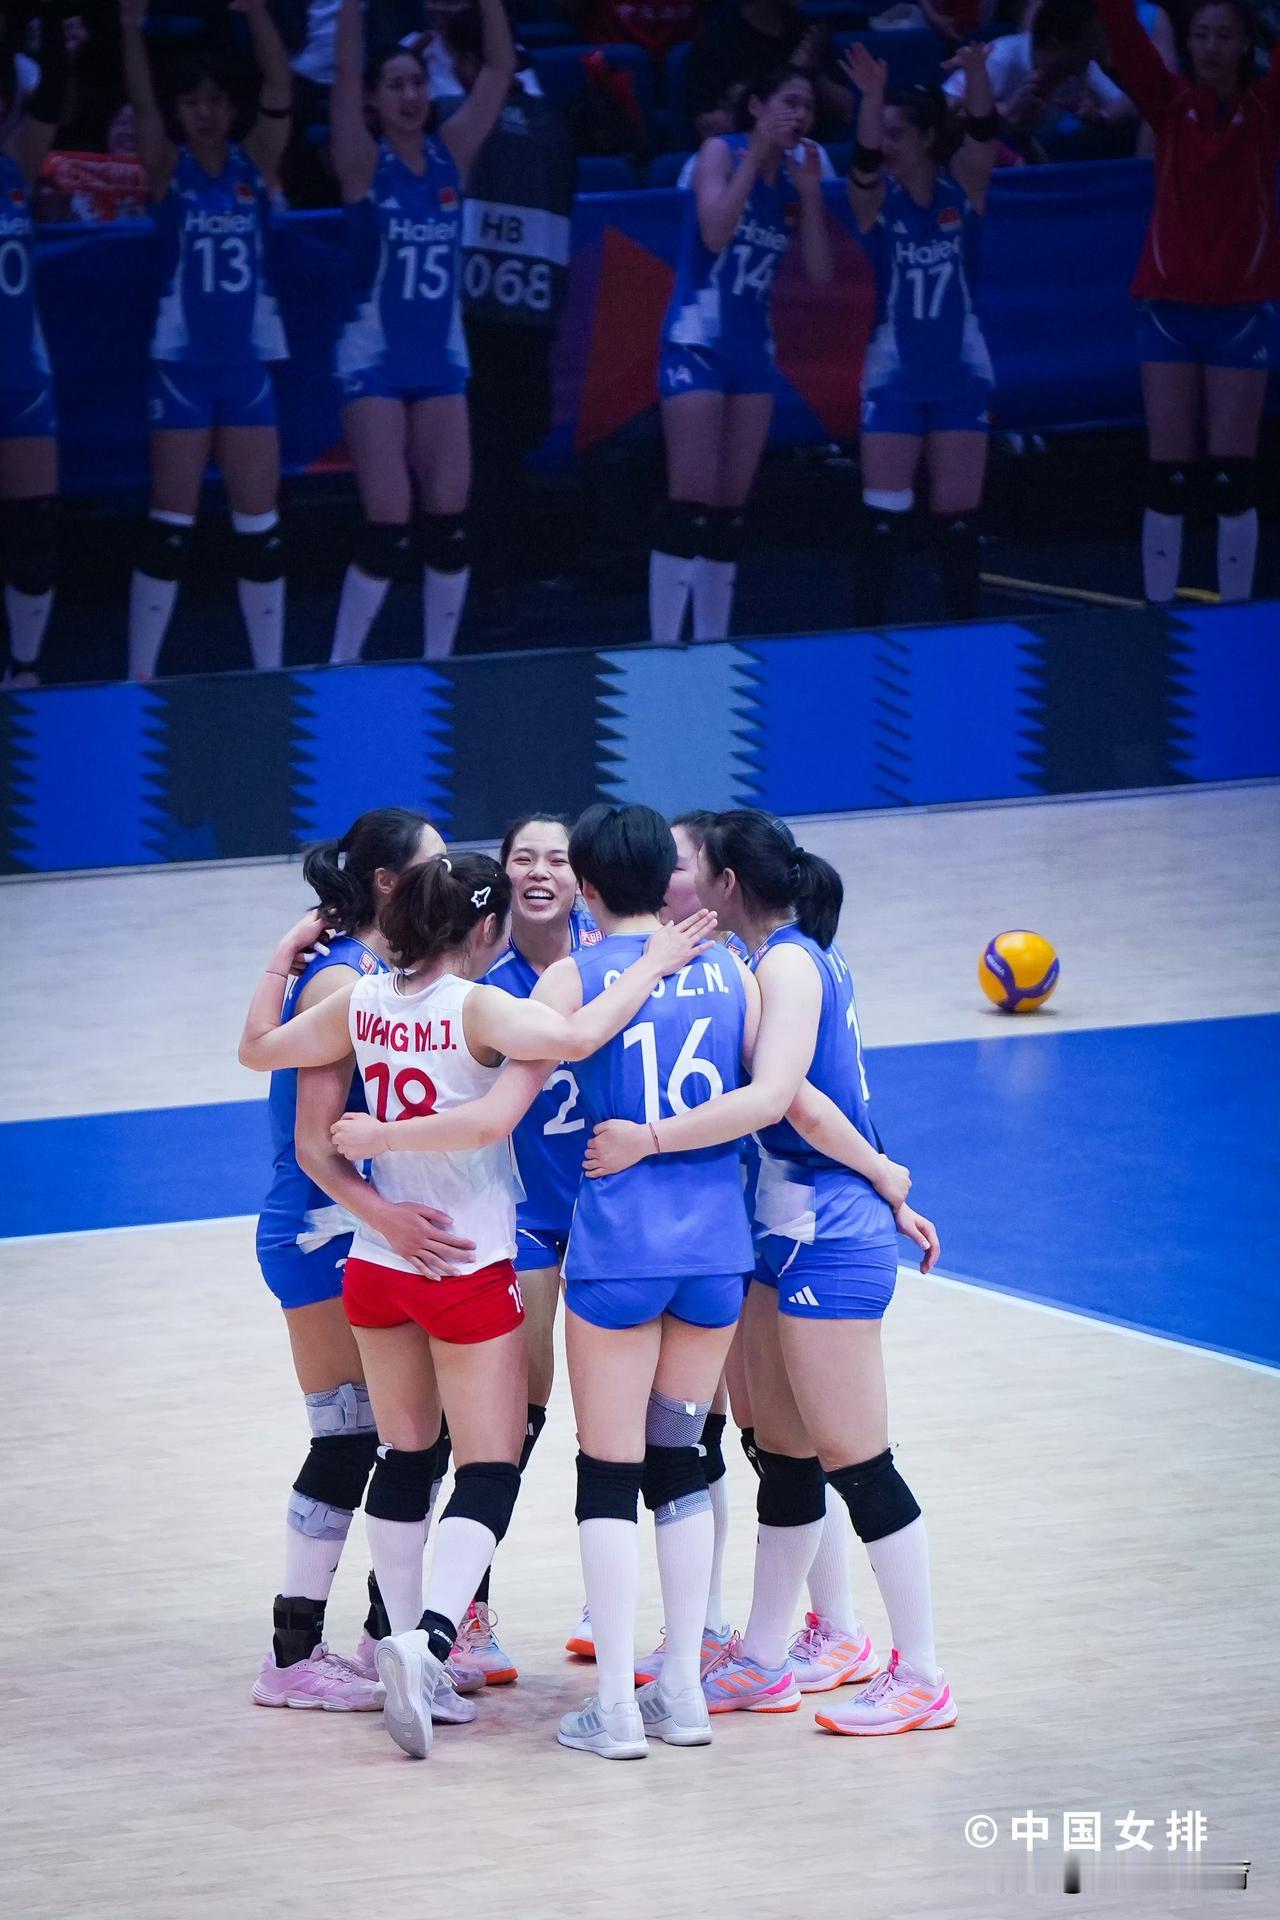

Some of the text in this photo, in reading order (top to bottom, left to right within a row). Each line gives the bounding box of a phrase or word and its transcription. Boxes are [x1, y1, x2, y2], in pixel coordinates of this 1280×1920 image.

[185, 210, 256, 234] Haier
[389, 217, 458, 242] Haier
[481, 211, 524, 243] HB
[193, 236, 250, 292] 13
[732, 244, 776, 297] 14
[895, 235, 961, 265] Haier
[397, 244, 450, 300] 15
[464, 253, 552, 310] 068
[905, 261, 954, 319] 17
[676, 963, 729, 997] Z.N.
[415, 1020, 457, 1052] M.J.
[623, 1016, 724, 1124] 16
